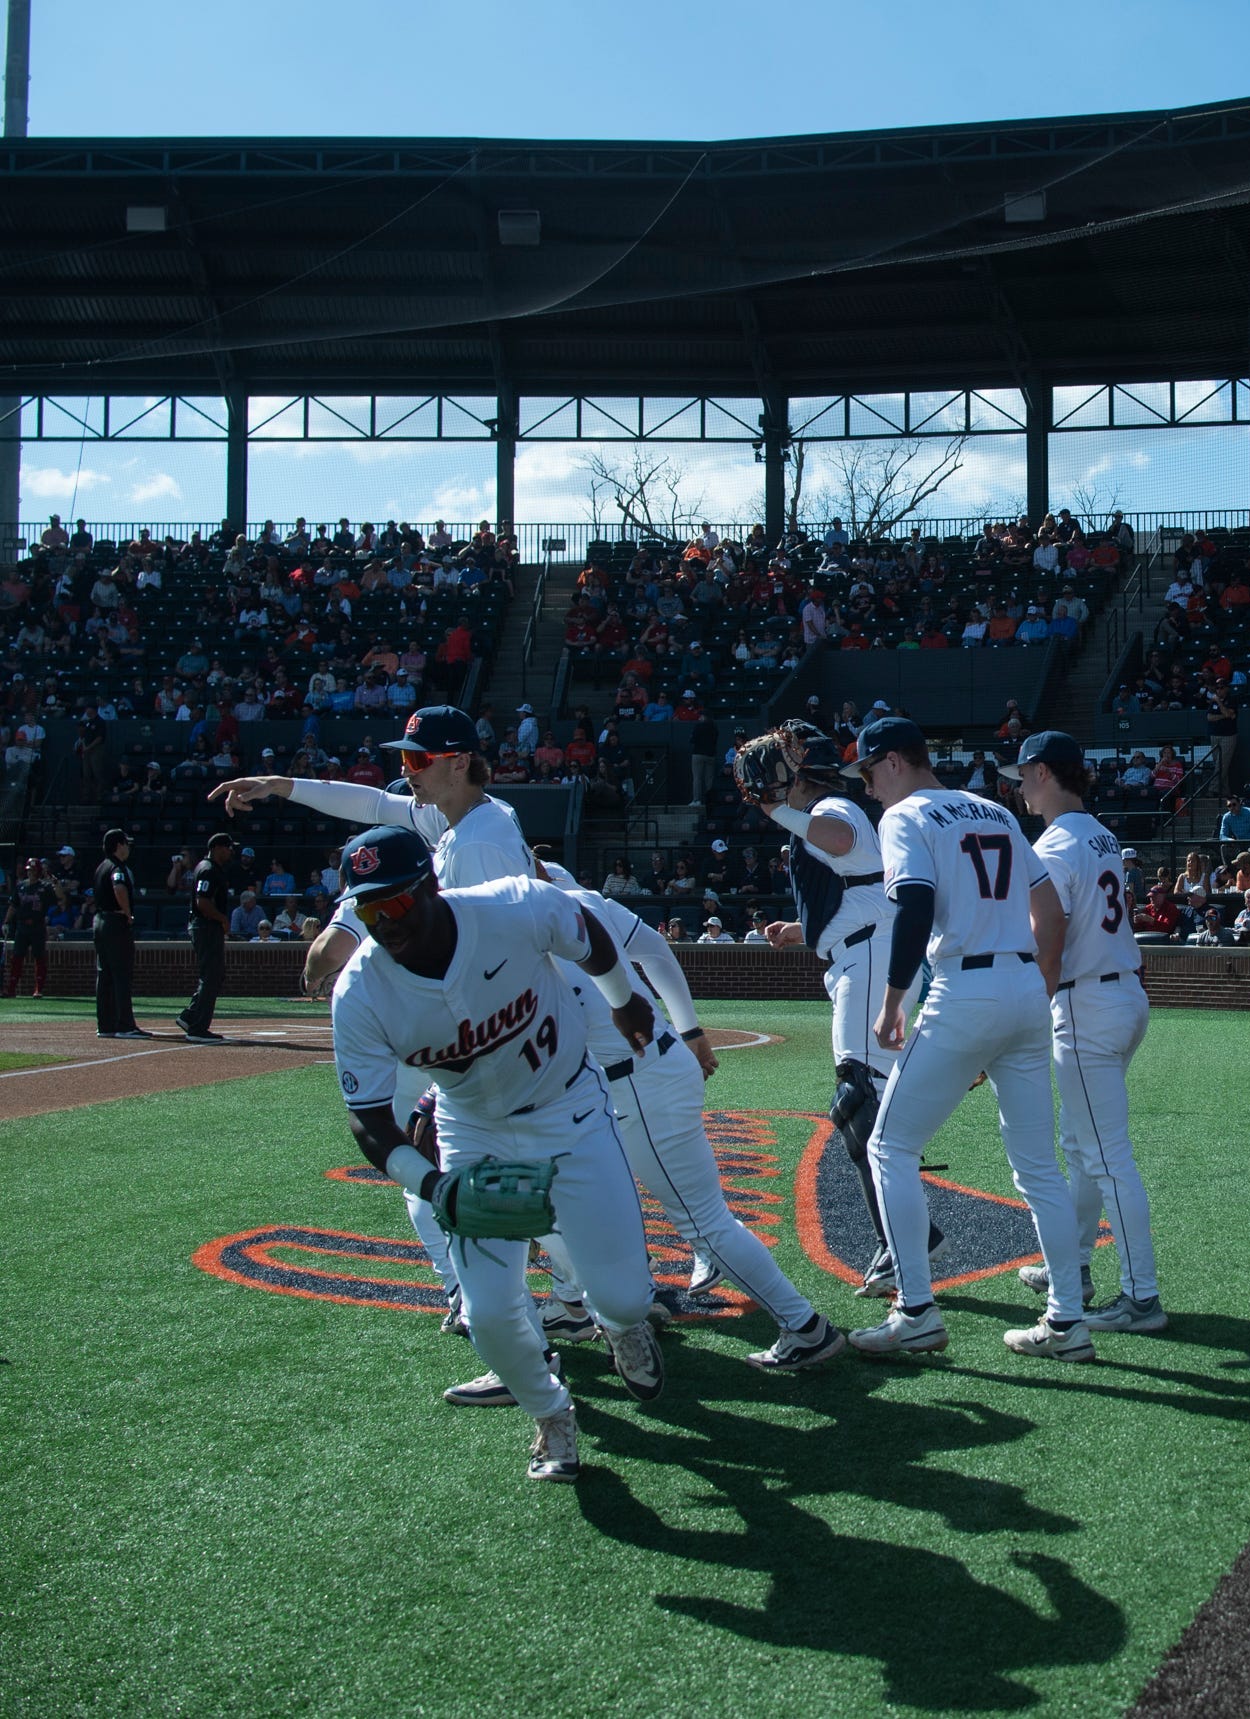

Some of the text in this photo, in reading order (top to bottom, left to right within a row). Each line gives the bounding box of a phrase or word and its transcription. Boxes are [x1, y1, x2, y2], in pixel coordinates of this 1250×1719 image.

[960, 833, 1013, 900] 17
[405, 988, 538, 1068] Auburn
[518, 1015, 558, 1073] 19
